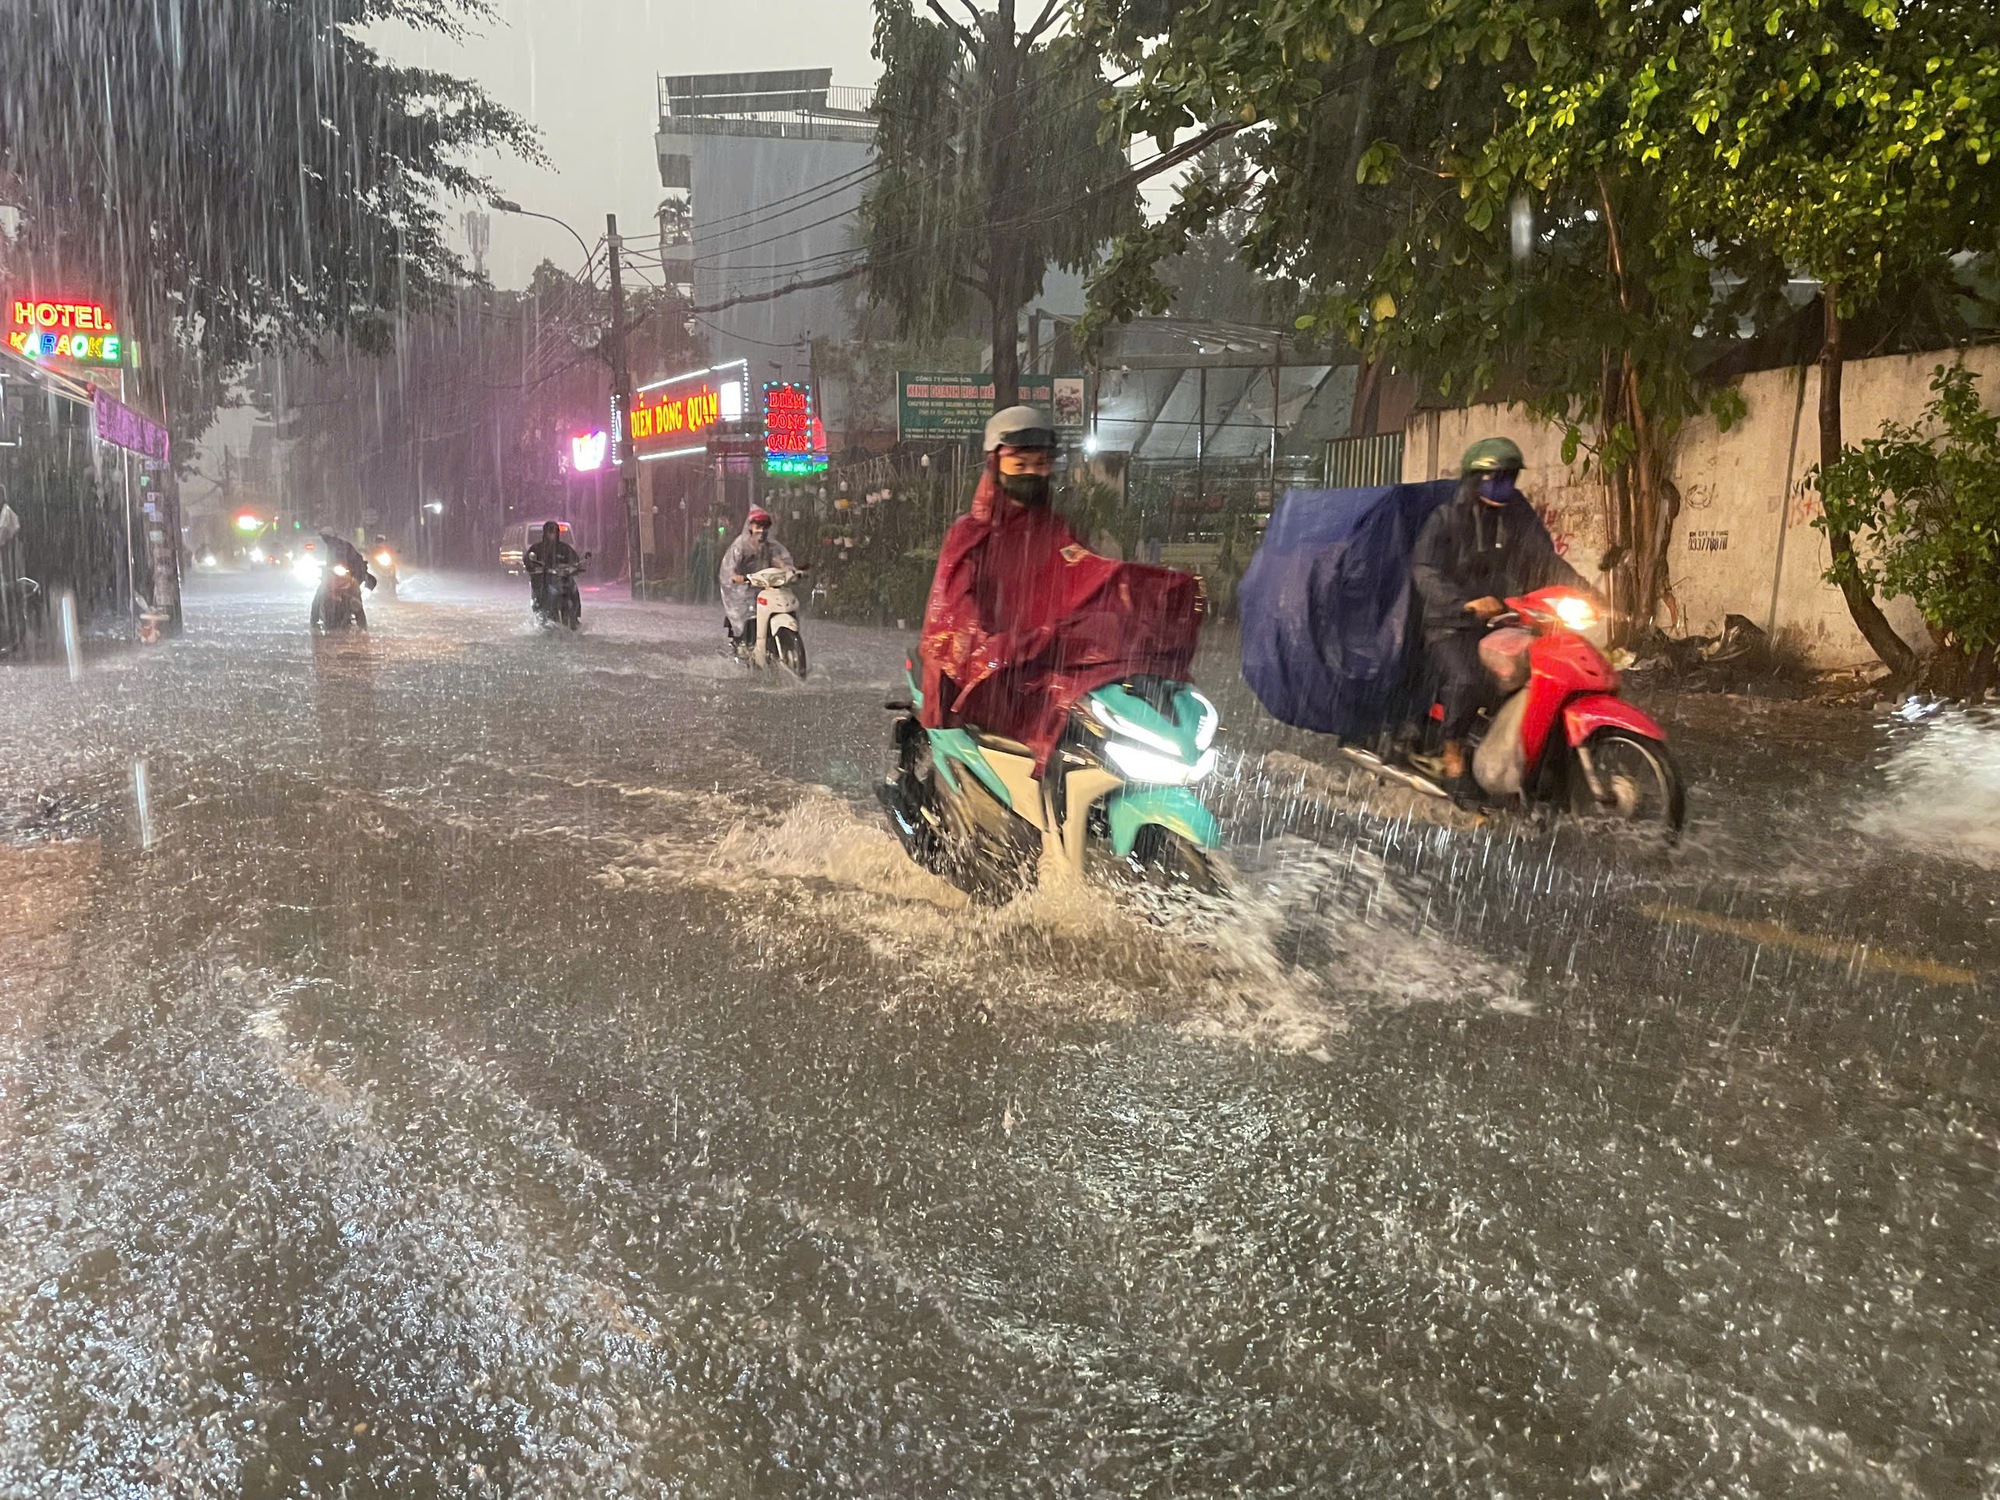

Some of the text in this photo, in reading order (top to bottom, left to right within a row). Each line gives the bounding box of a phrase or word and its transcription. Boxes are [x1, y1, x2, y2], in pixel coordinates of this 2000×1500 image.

[14, 301, 112, 331] HOTEL
[9, 332, 120, 360] KARAOKE
[907, 384, 929, 398] KINH
[930, 385, 960, 398] DOANH
[961, 385, 979, 399] HOA
[687, 384, 718, 432] QUÁN
[766, 431, 809, 453] QUÁN
